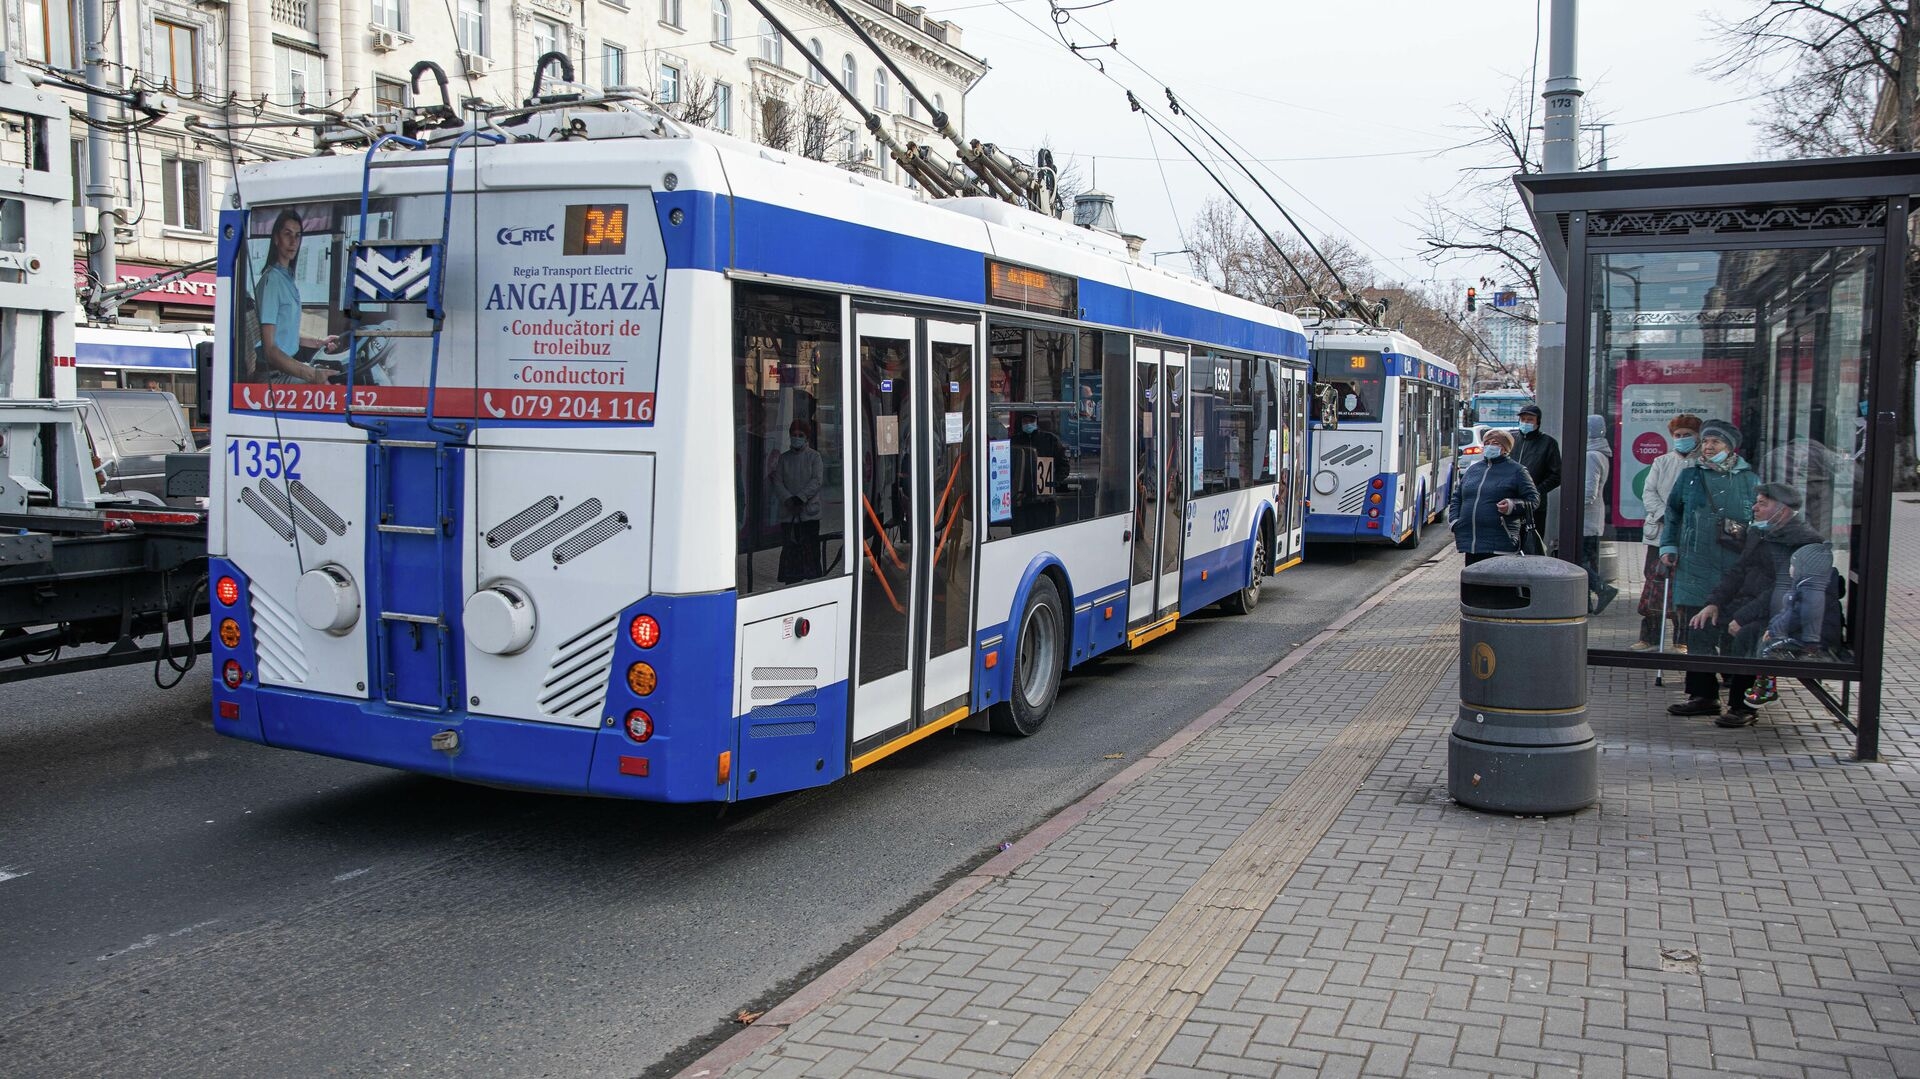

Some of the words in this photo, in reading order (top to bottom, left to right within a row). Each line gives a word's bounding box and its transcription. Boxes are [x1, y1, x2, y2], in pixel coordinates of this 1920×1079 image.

[1551, 98, 1571, 108] 173
[586, 210, 625, 244] 34
[513, 266, 540, 279] Regia
[542, 266, 592, 278] Transport
[594, 264, 633, 276] Electric
[485, 274, 660, 317] ANGAJEAZĂ
[511, 319, 615, 337] Conducători
[619, 319, 641, 337] de
[533, 338, 611, 356] troleibuz
[1351, 356, 1366, 369] 30
[521, 365, 625, 385] Conductori
[1214, 366, 1230, 392] 1352
[264, 389, 297, 409] 022
[302, 390, 338, 410] 204
[511, 395, 553, 417] 079
[558, 396, 602, 419] 204
[608, 398, 652, 421] 116
[228, 439, 301, 480] 1352
[1037, 460, 1053, 494] 34
[1213, 508, 1230, 534] 1352
